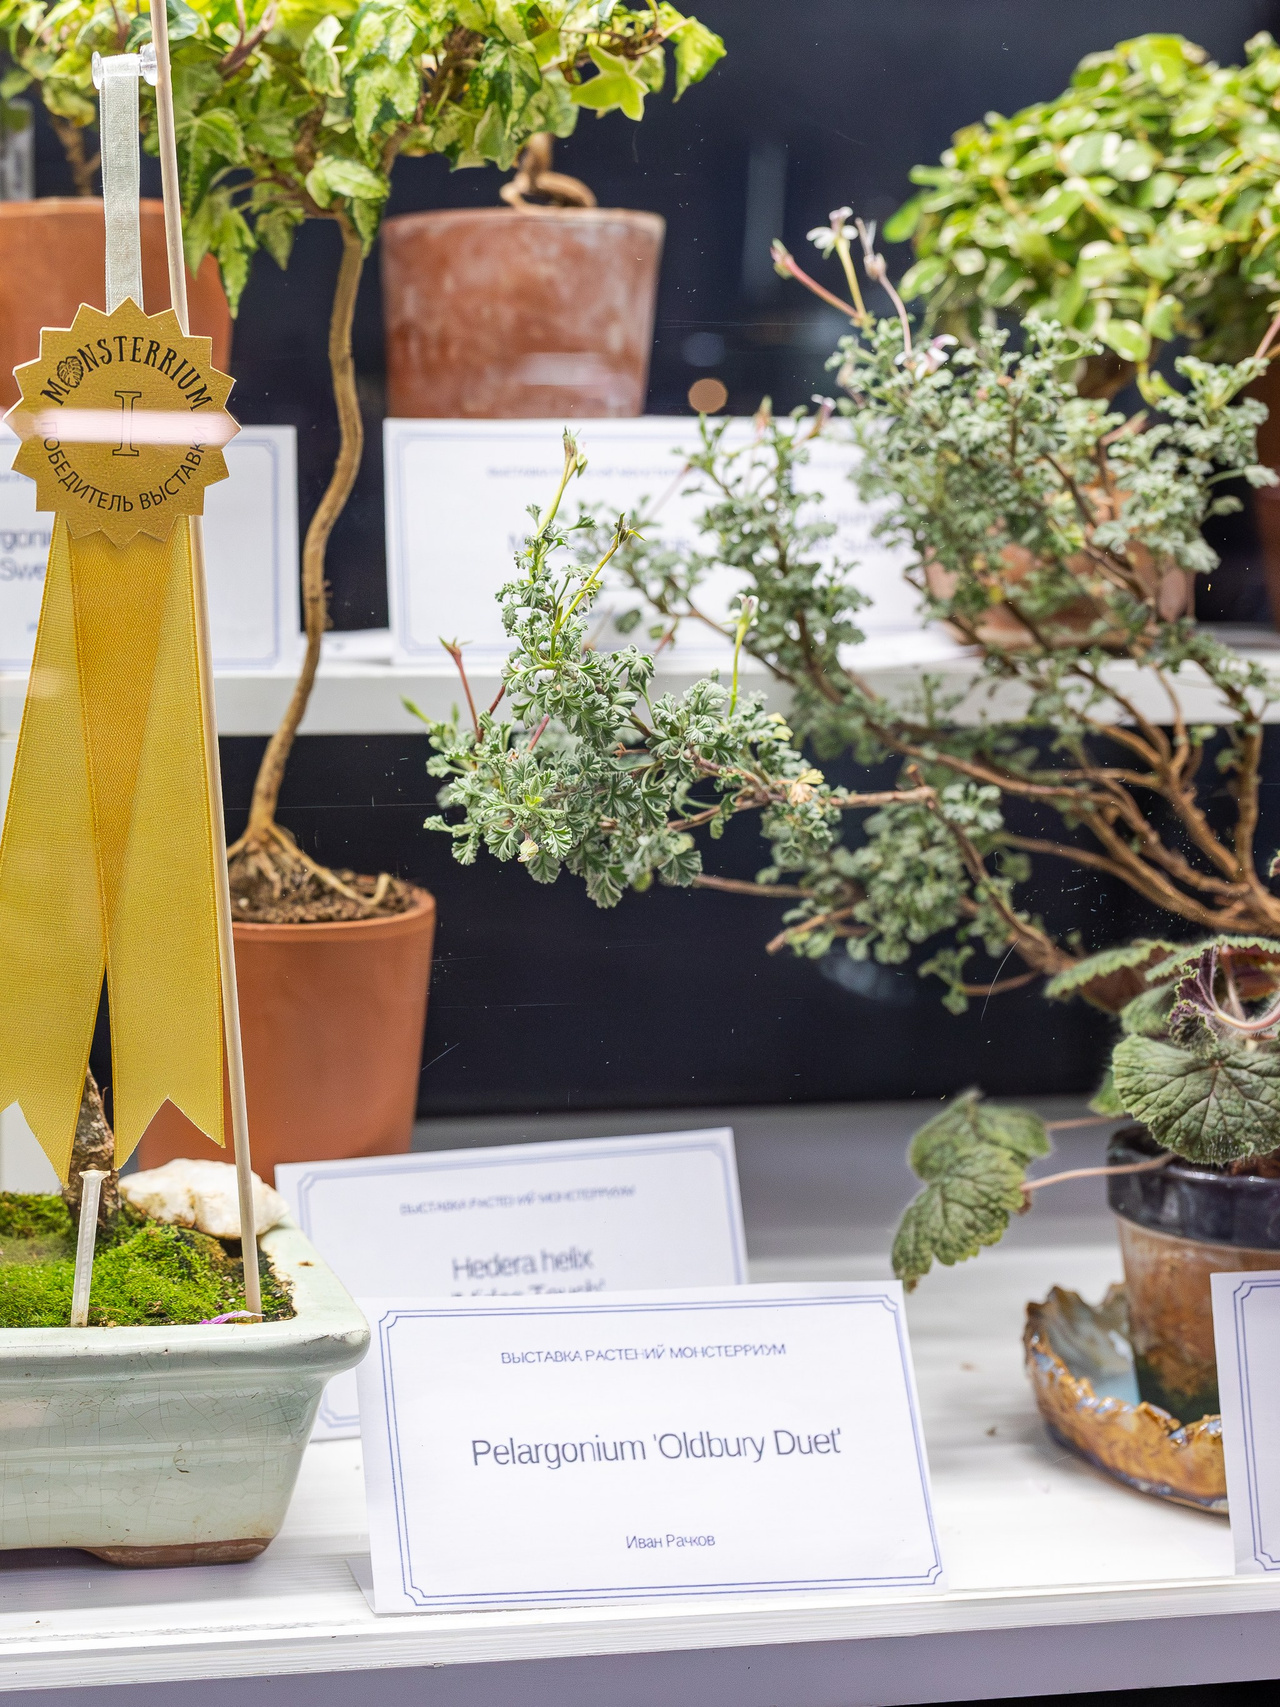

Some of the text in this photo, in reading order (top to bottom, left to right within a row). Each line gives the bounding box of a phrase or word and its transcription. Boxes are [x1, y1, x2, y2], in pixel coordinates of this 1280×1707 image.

[451, 1245, 594, 1281] Hedera helix
[501, 1343, 787, 1365] ВЫСТАВКА РАСТЕНИЙ МОНСТЕРРИУМ
[471, 1434, 647, 1470] Pelargonium
[653, 1430, 765, 1463] 'Oldbury
[625, 1533, 716, 1550] Иван Рачков
